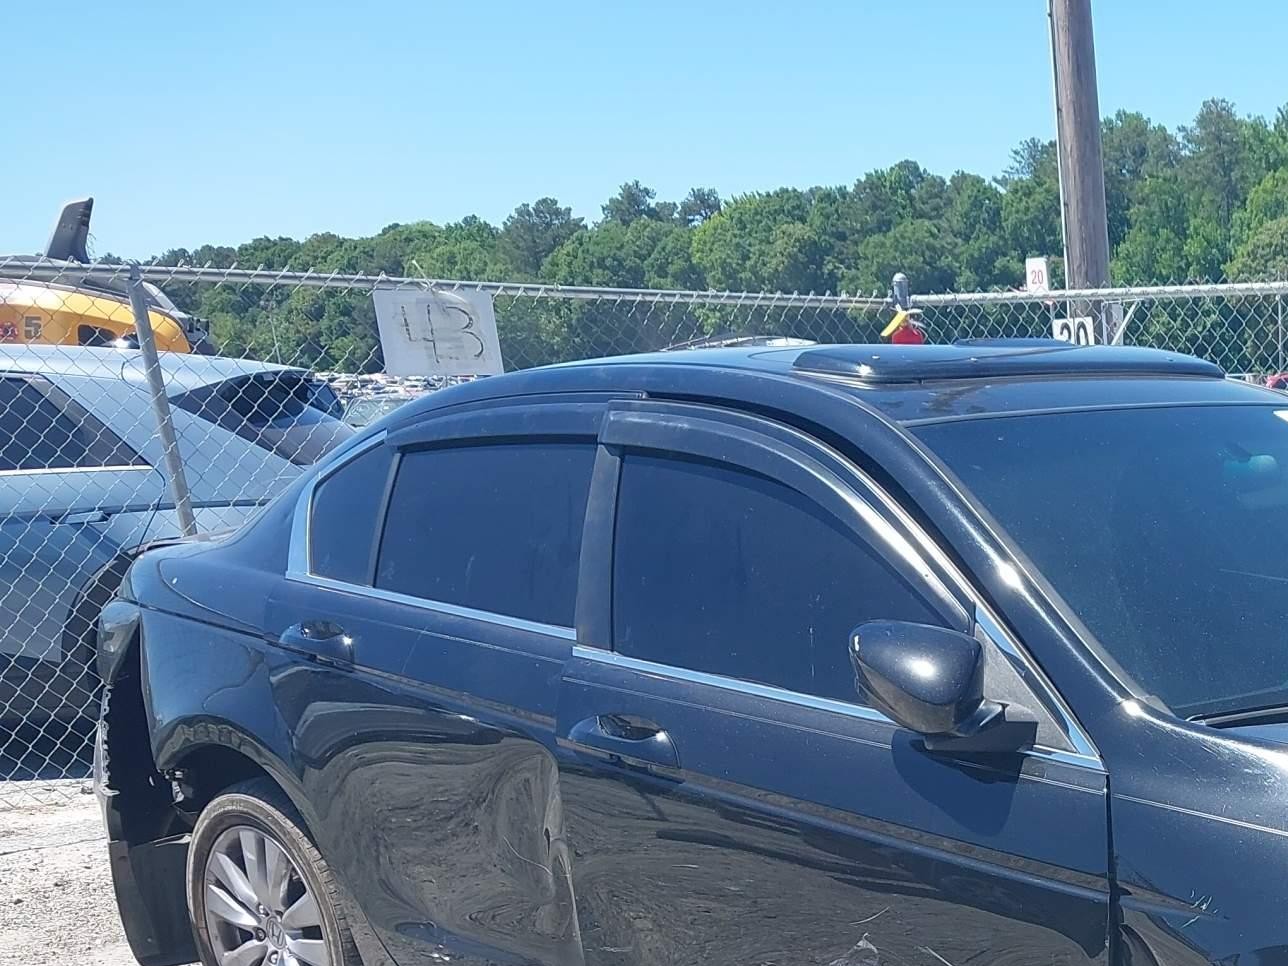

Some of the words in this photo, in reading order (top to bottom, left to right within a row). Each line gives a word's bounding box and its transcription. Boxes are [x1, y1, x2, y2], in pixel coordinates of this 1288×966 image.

[1031, 270, 1044, 285] 20
[24, 316, 42, 340] 5
[401, 304, 484, 364] 43
